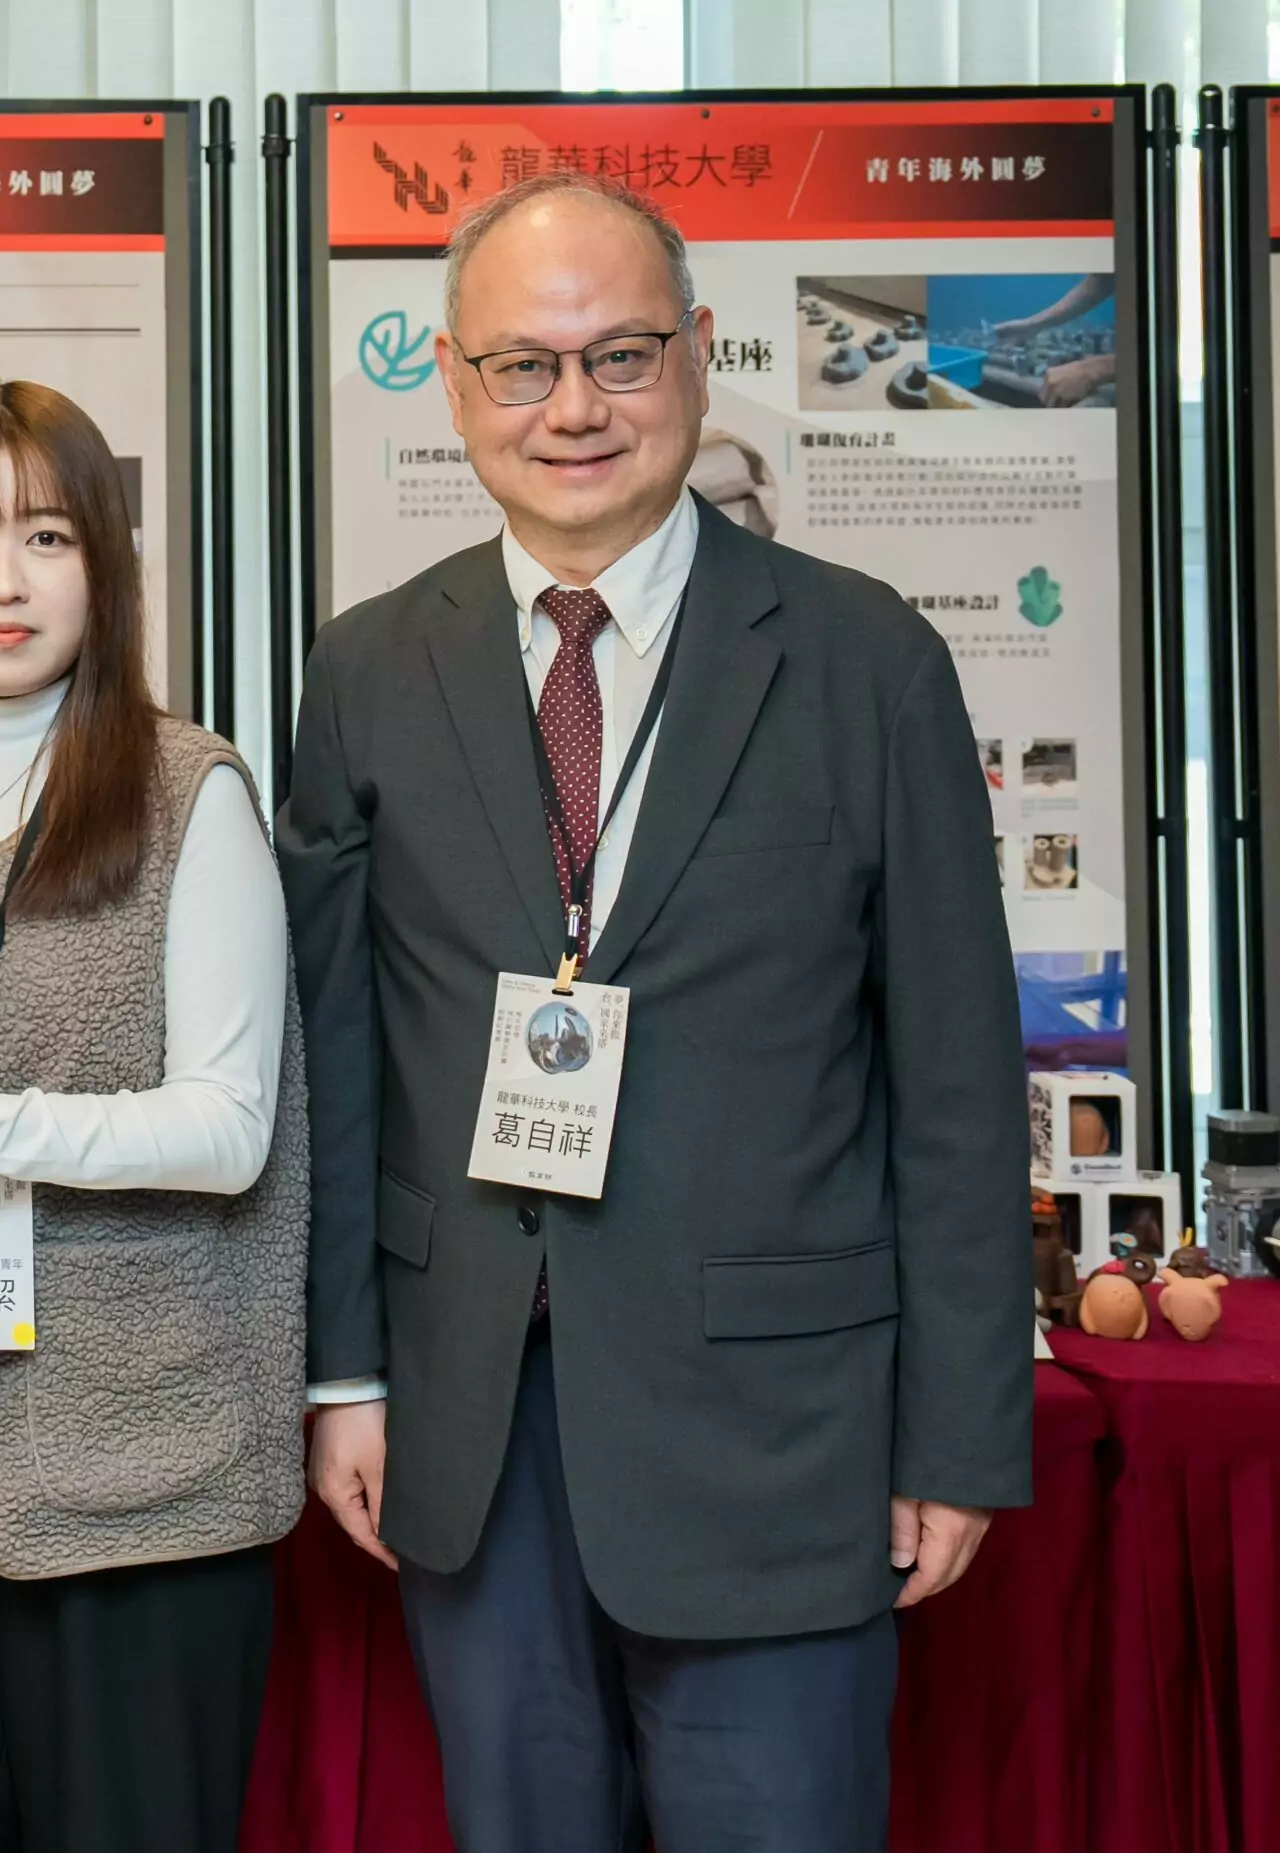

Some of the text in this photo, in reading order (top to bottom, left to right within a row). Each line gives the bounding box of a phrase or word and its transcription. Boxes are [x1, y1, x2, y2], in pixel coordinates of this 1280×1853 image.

[866, 156, 1046, 183] 青年海外圓夢
[496, 1090, 598, 1119] 龍華科技大學 校長
[491, 1111, 594, 1160] 葛自祥
